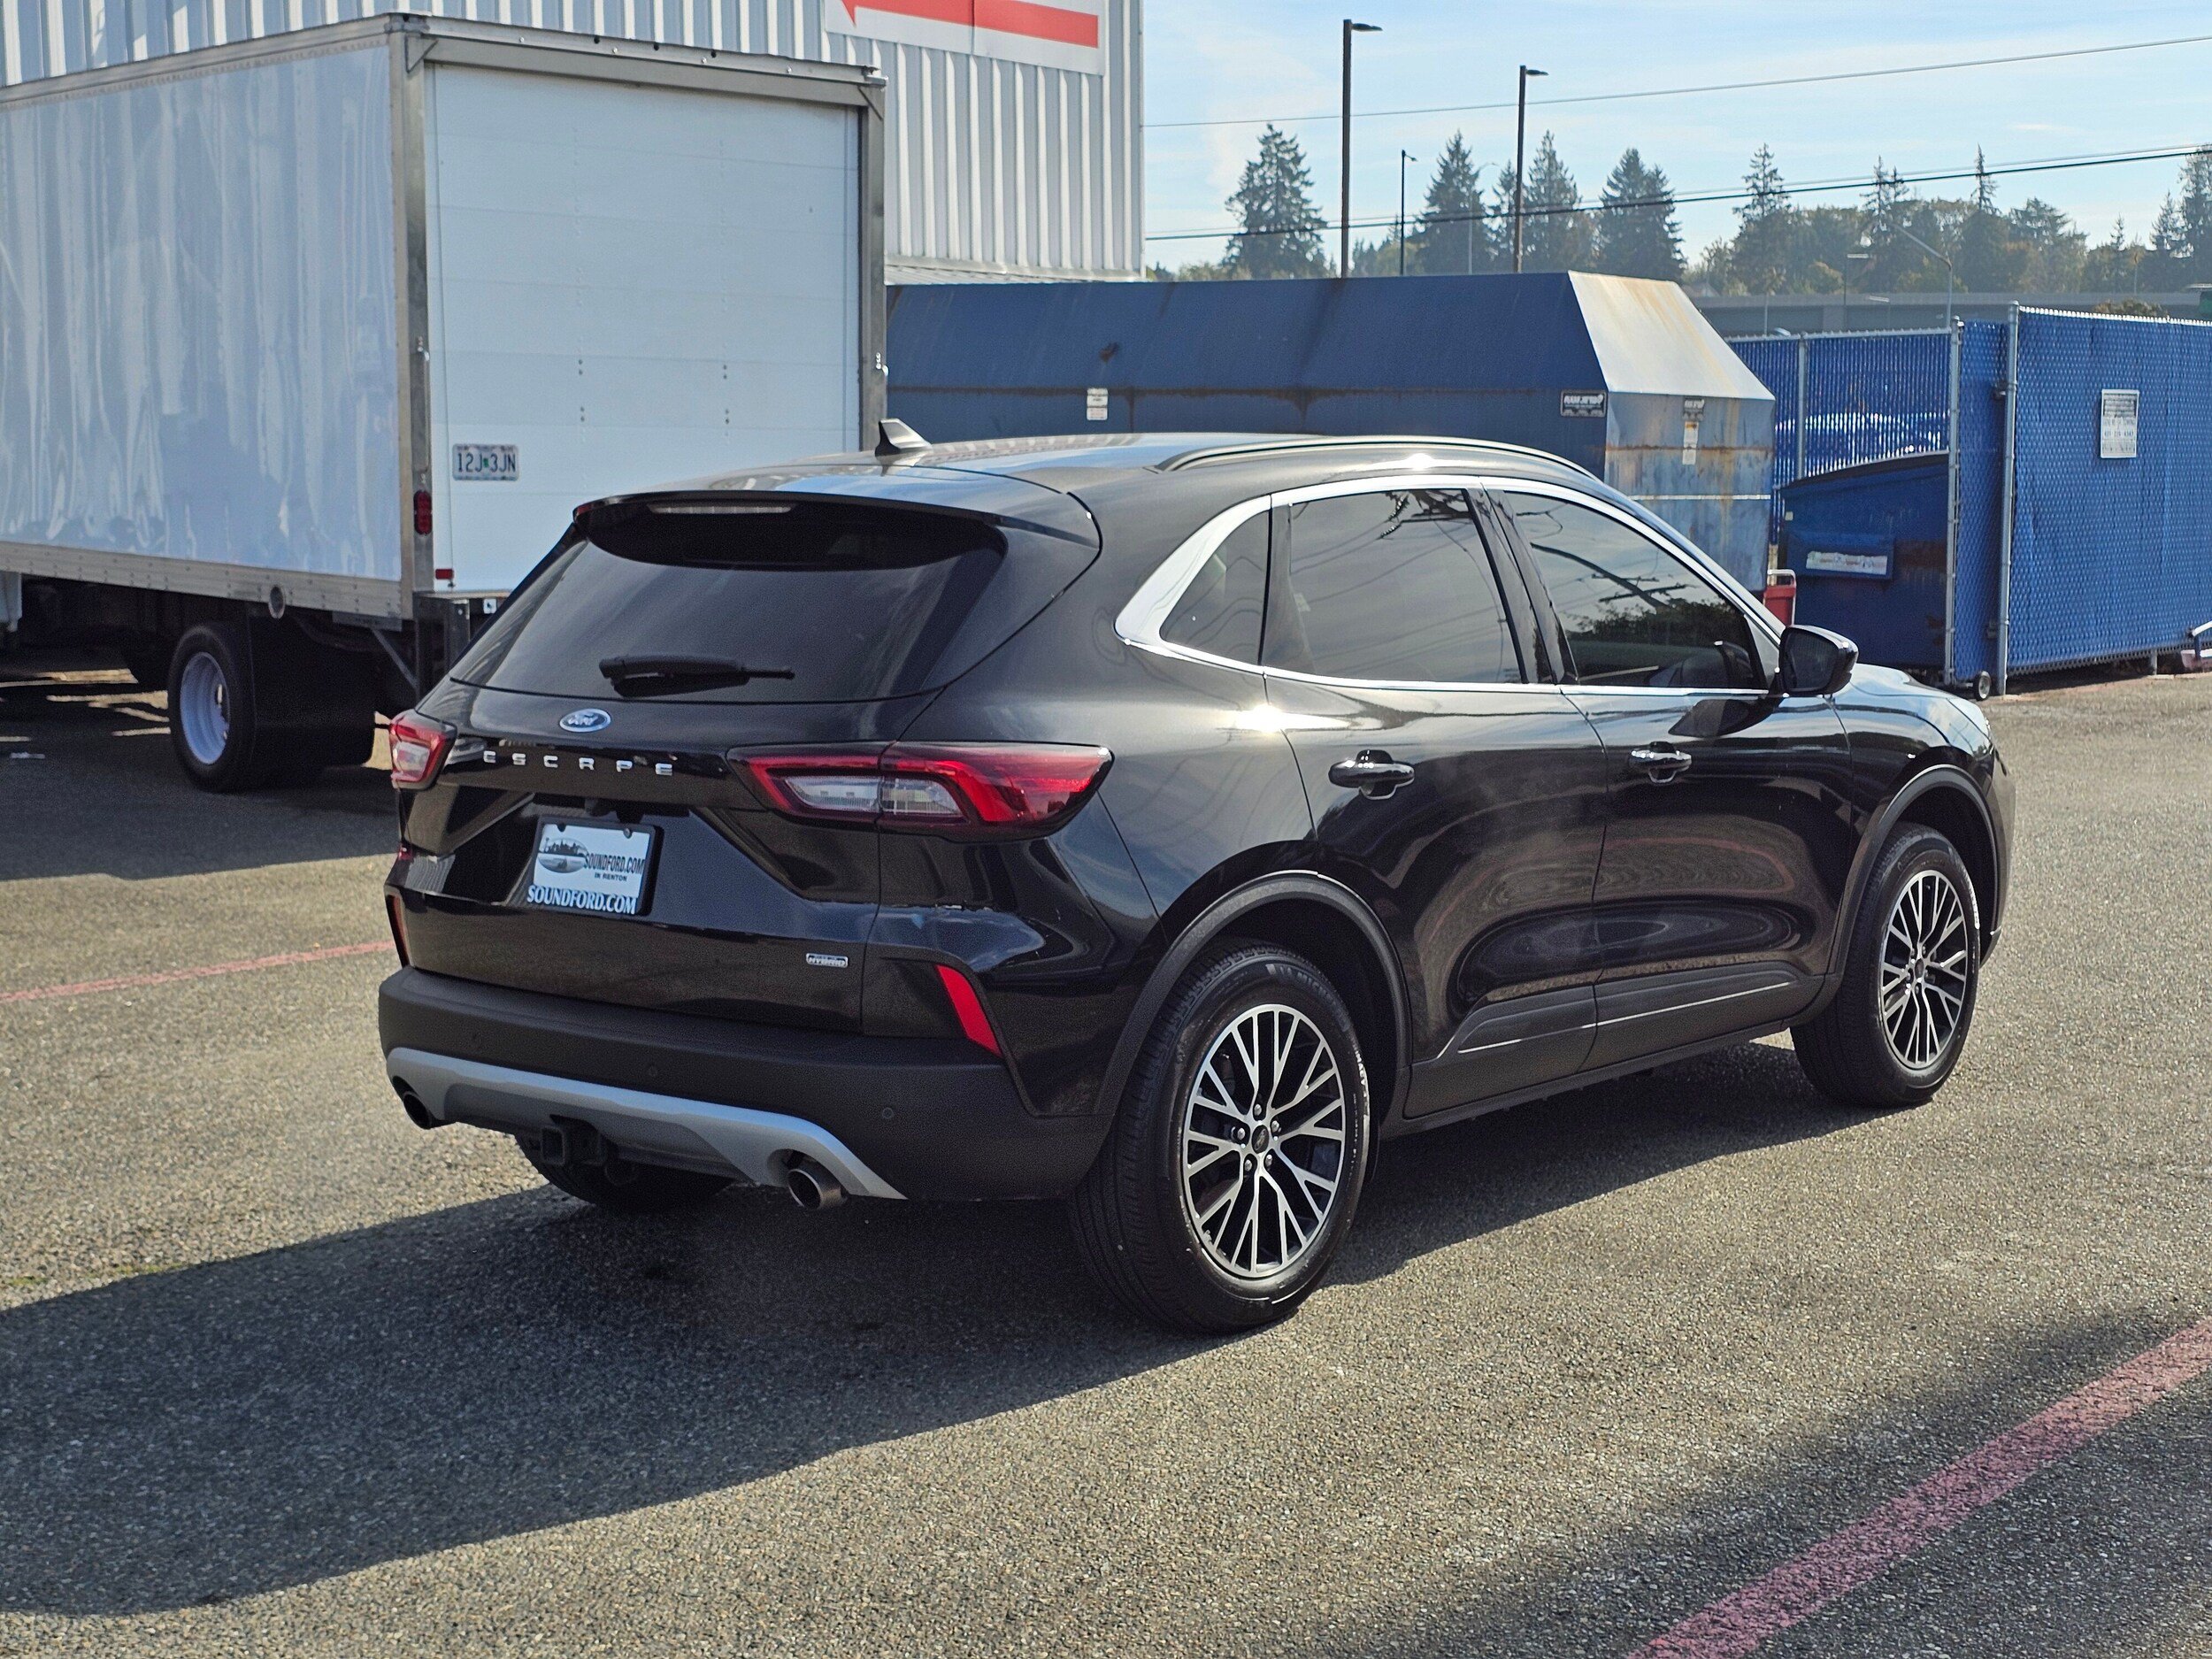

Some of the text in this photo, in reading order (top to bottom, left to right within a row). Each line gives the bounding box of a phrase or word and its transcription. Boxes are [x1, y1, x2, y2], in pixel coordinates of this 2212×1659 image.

[457, 452, 516, 473] 12J 3JN
[483, 750, 672, 776] ESCAPE
[584, 853, 645, 875] SOUNDFORD.COM
[603, 872, 628, 882] RENTON
[527, 885, 636, 914] SOUNDFORD.COM
